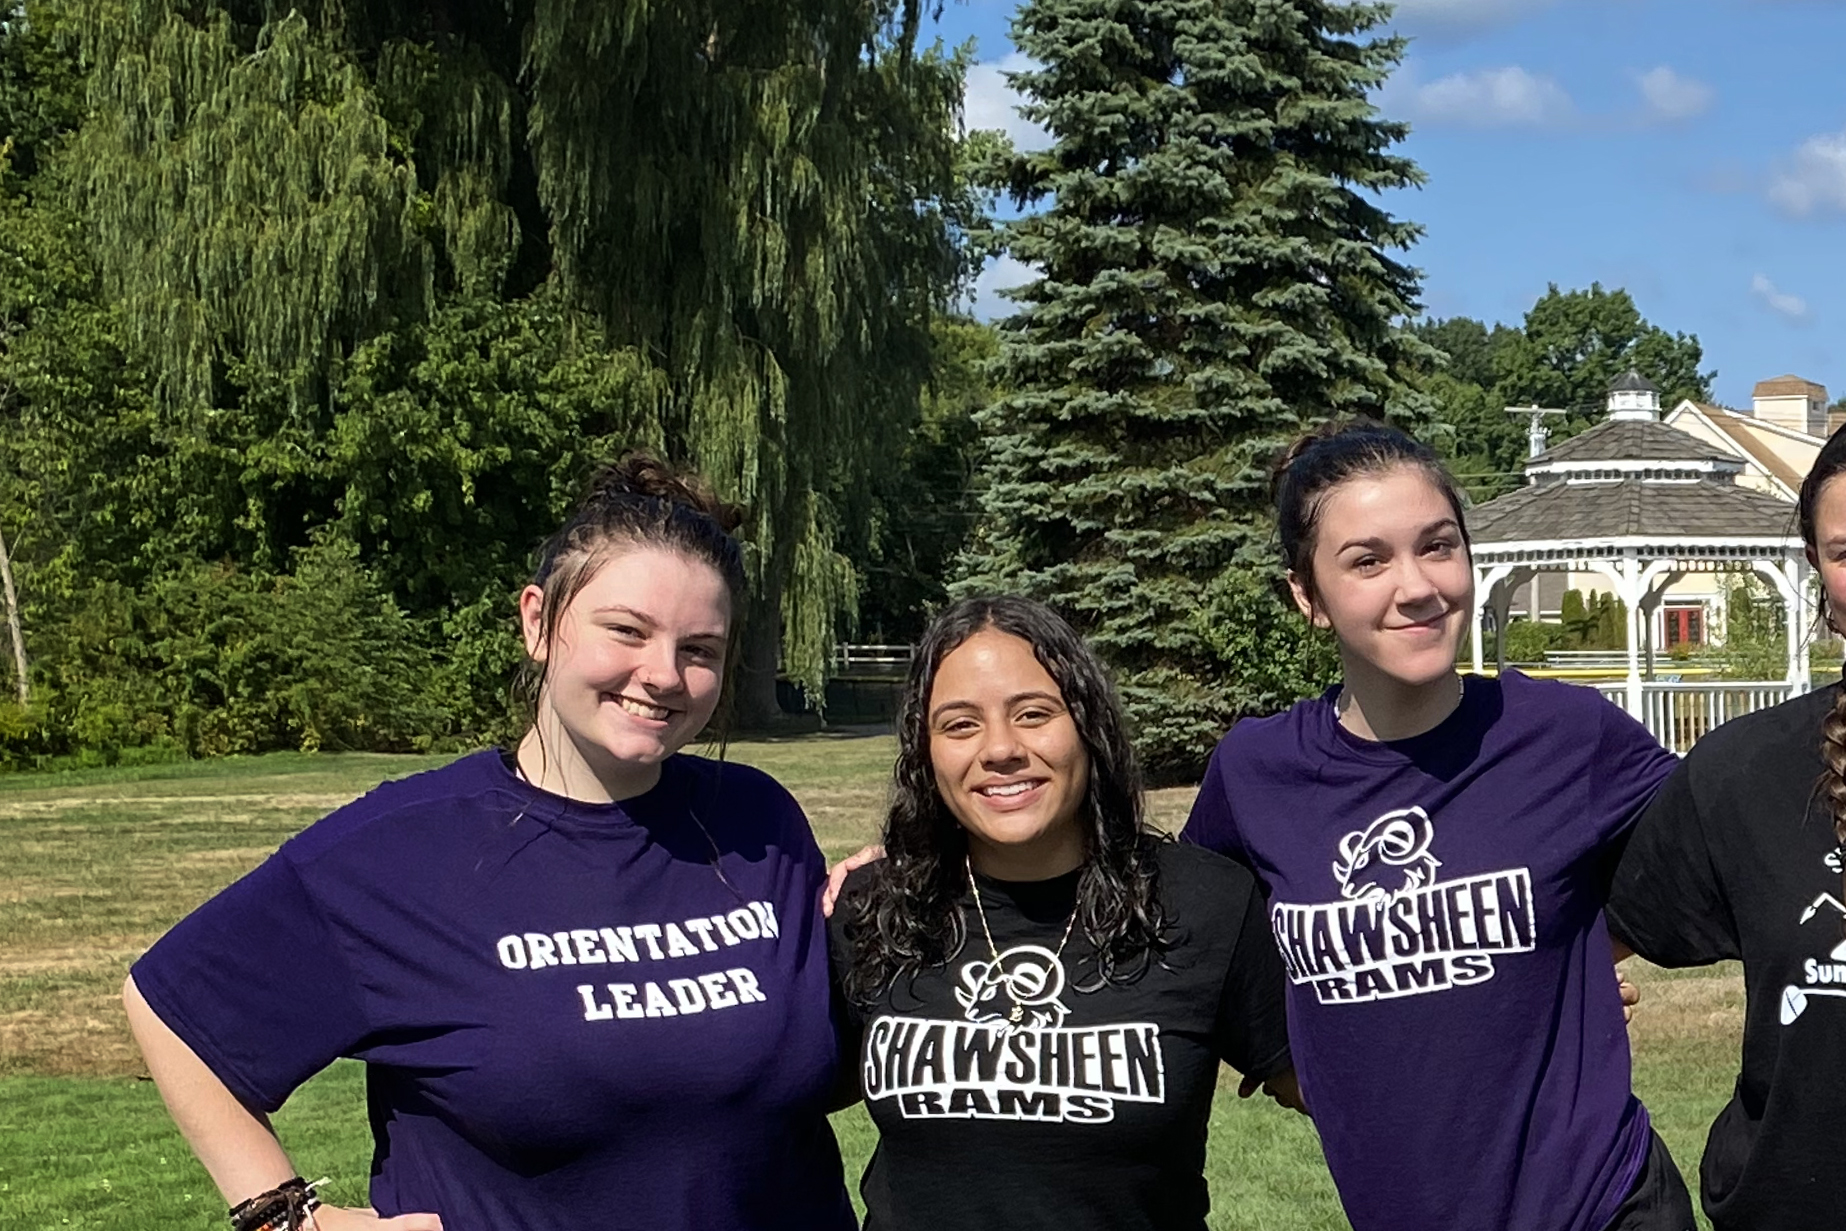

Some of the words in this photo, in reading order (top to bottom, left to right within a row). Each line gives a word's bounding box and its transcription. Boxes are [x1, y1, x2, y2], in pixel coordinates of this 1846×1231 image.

[497, 901, 779, 970] ORIENTATION
[1273, 868, 1536, 984] SHAWSHEEN
[577, 967, 767, 1021] LEADER
[1312, 953, 1495, 1004] RAMS
[864, 1016, 1165, 1103] SHAWSHEEN
[900, 1088, 1115, 1124] RAMS
